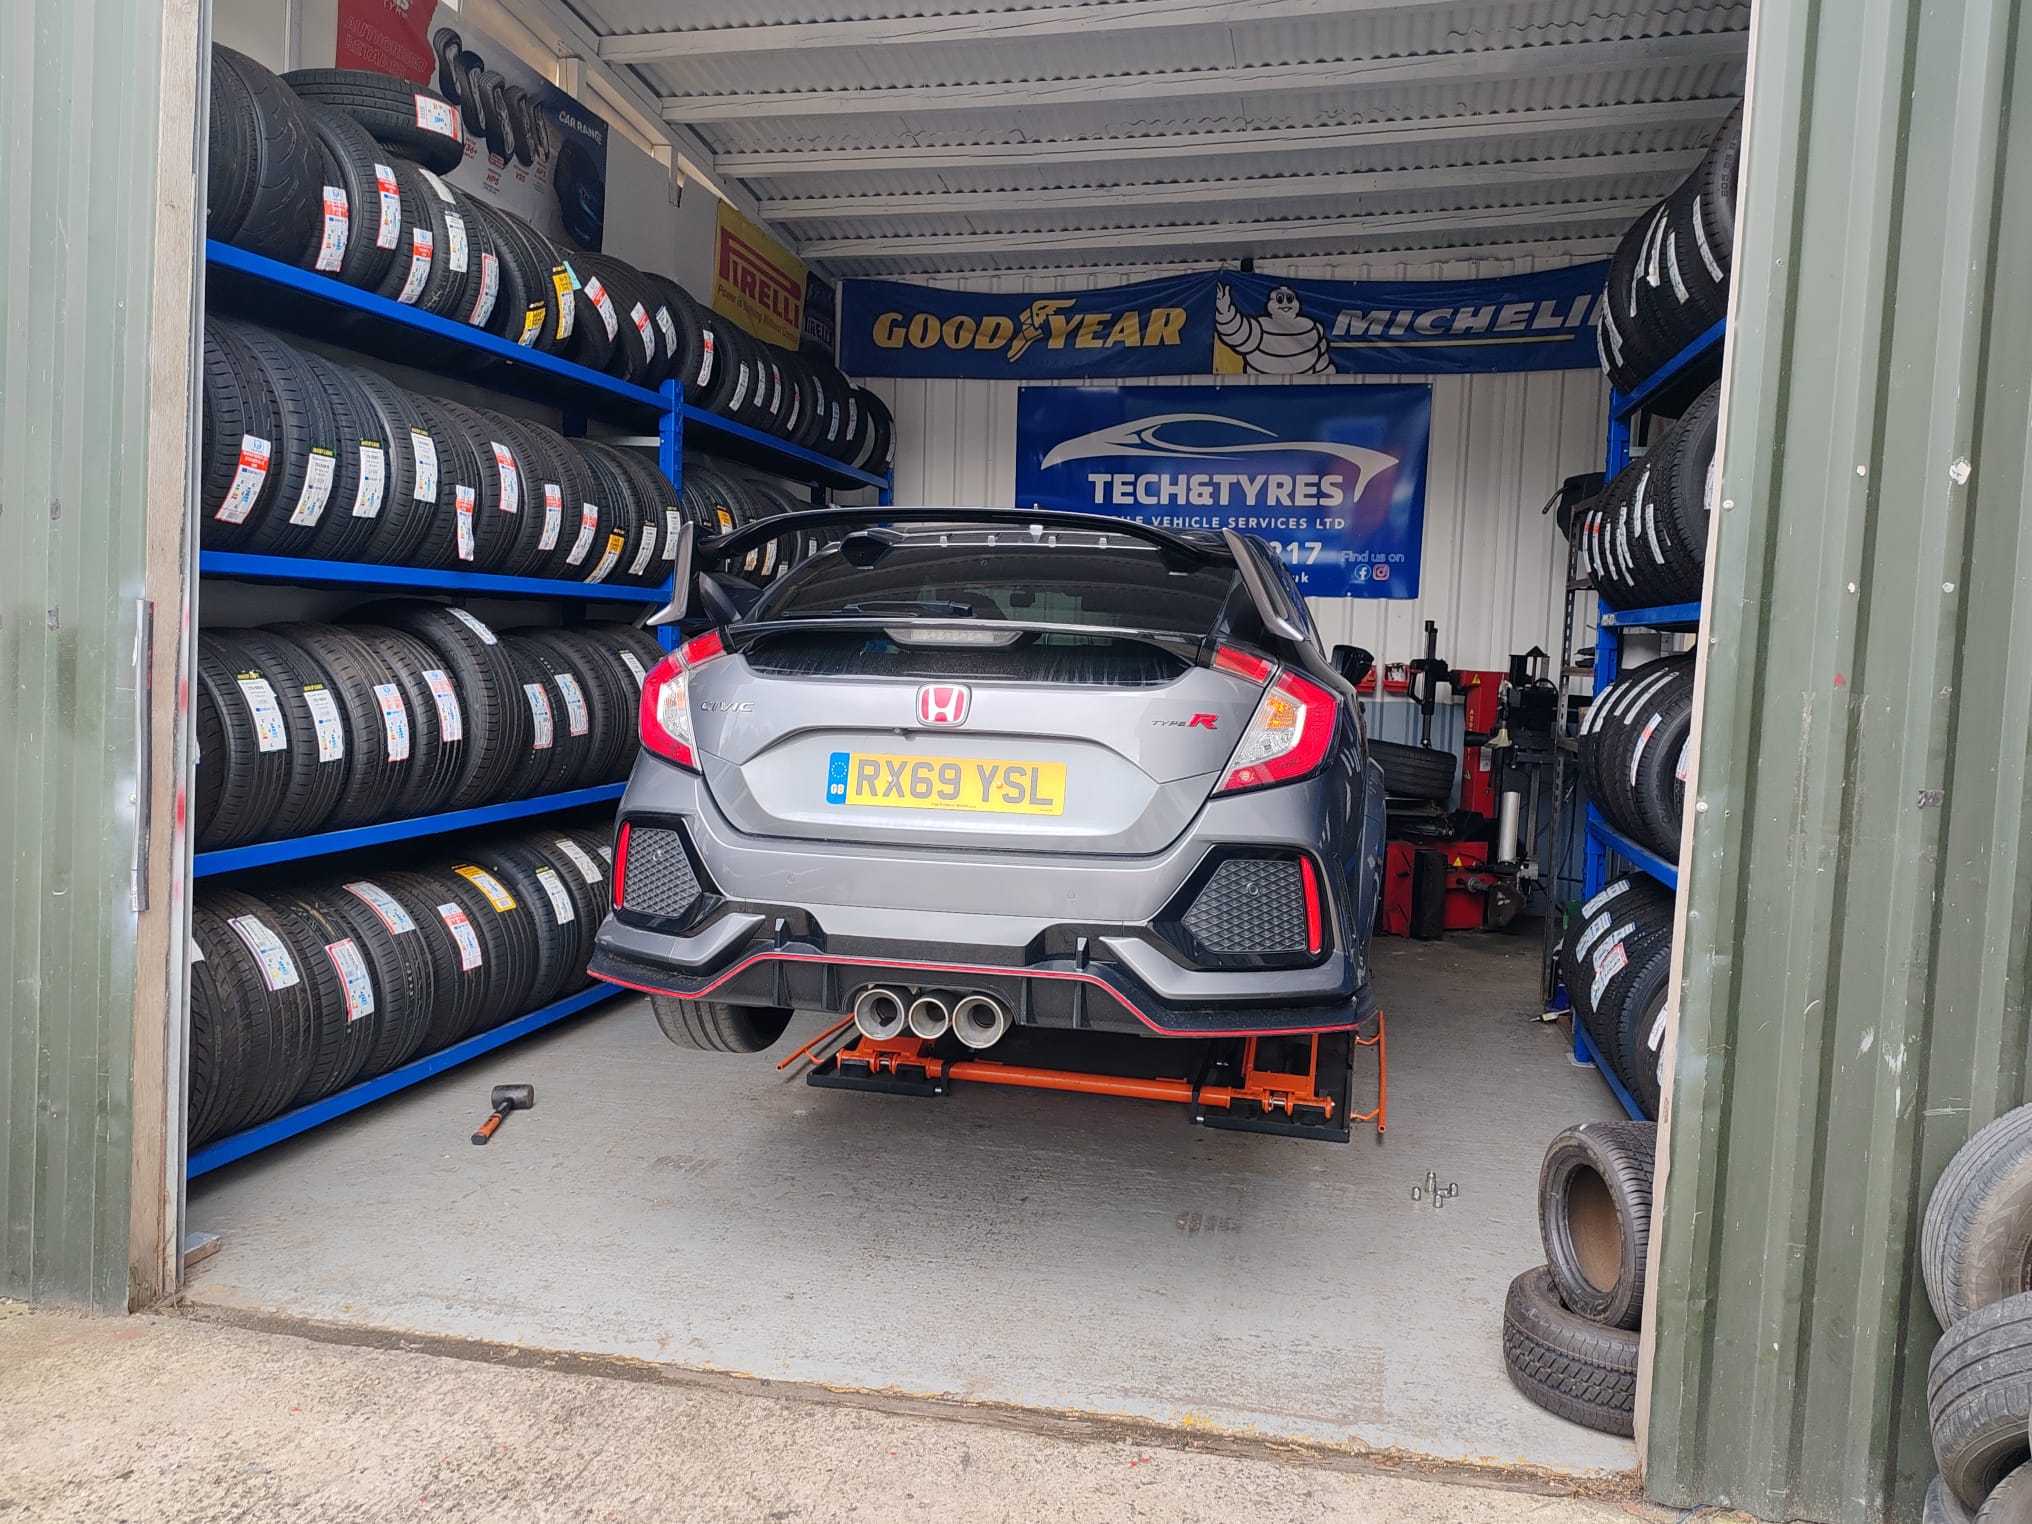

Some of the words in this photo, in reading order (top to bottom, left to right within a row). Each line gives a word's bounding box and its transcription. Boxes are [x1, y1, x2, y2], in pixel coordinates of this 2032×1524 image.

[558, 111, 577, 130] CAR
[577, 123, 603, 145] RANGE
[719, 226, 802, 329] PIRELLI
[1087, 473, 1344, 507] TECH&TYRES
[1151, 515, 1220, 529] VEHICLE
[1228, 516, 1307, 529] SERVICES
[1315, 518, 1345, 529] LTD
[1341, 550, 1368, 562] Find
[1371, 553, 1386, 562] us
[1388, 553, 1405, 562] on
[701, 701, 755, 712] CIVIC
[1187, 713, 1219, 729] R
[855, 758, 962, 801] RX69
[976, 764, 1054, 806] YSL
